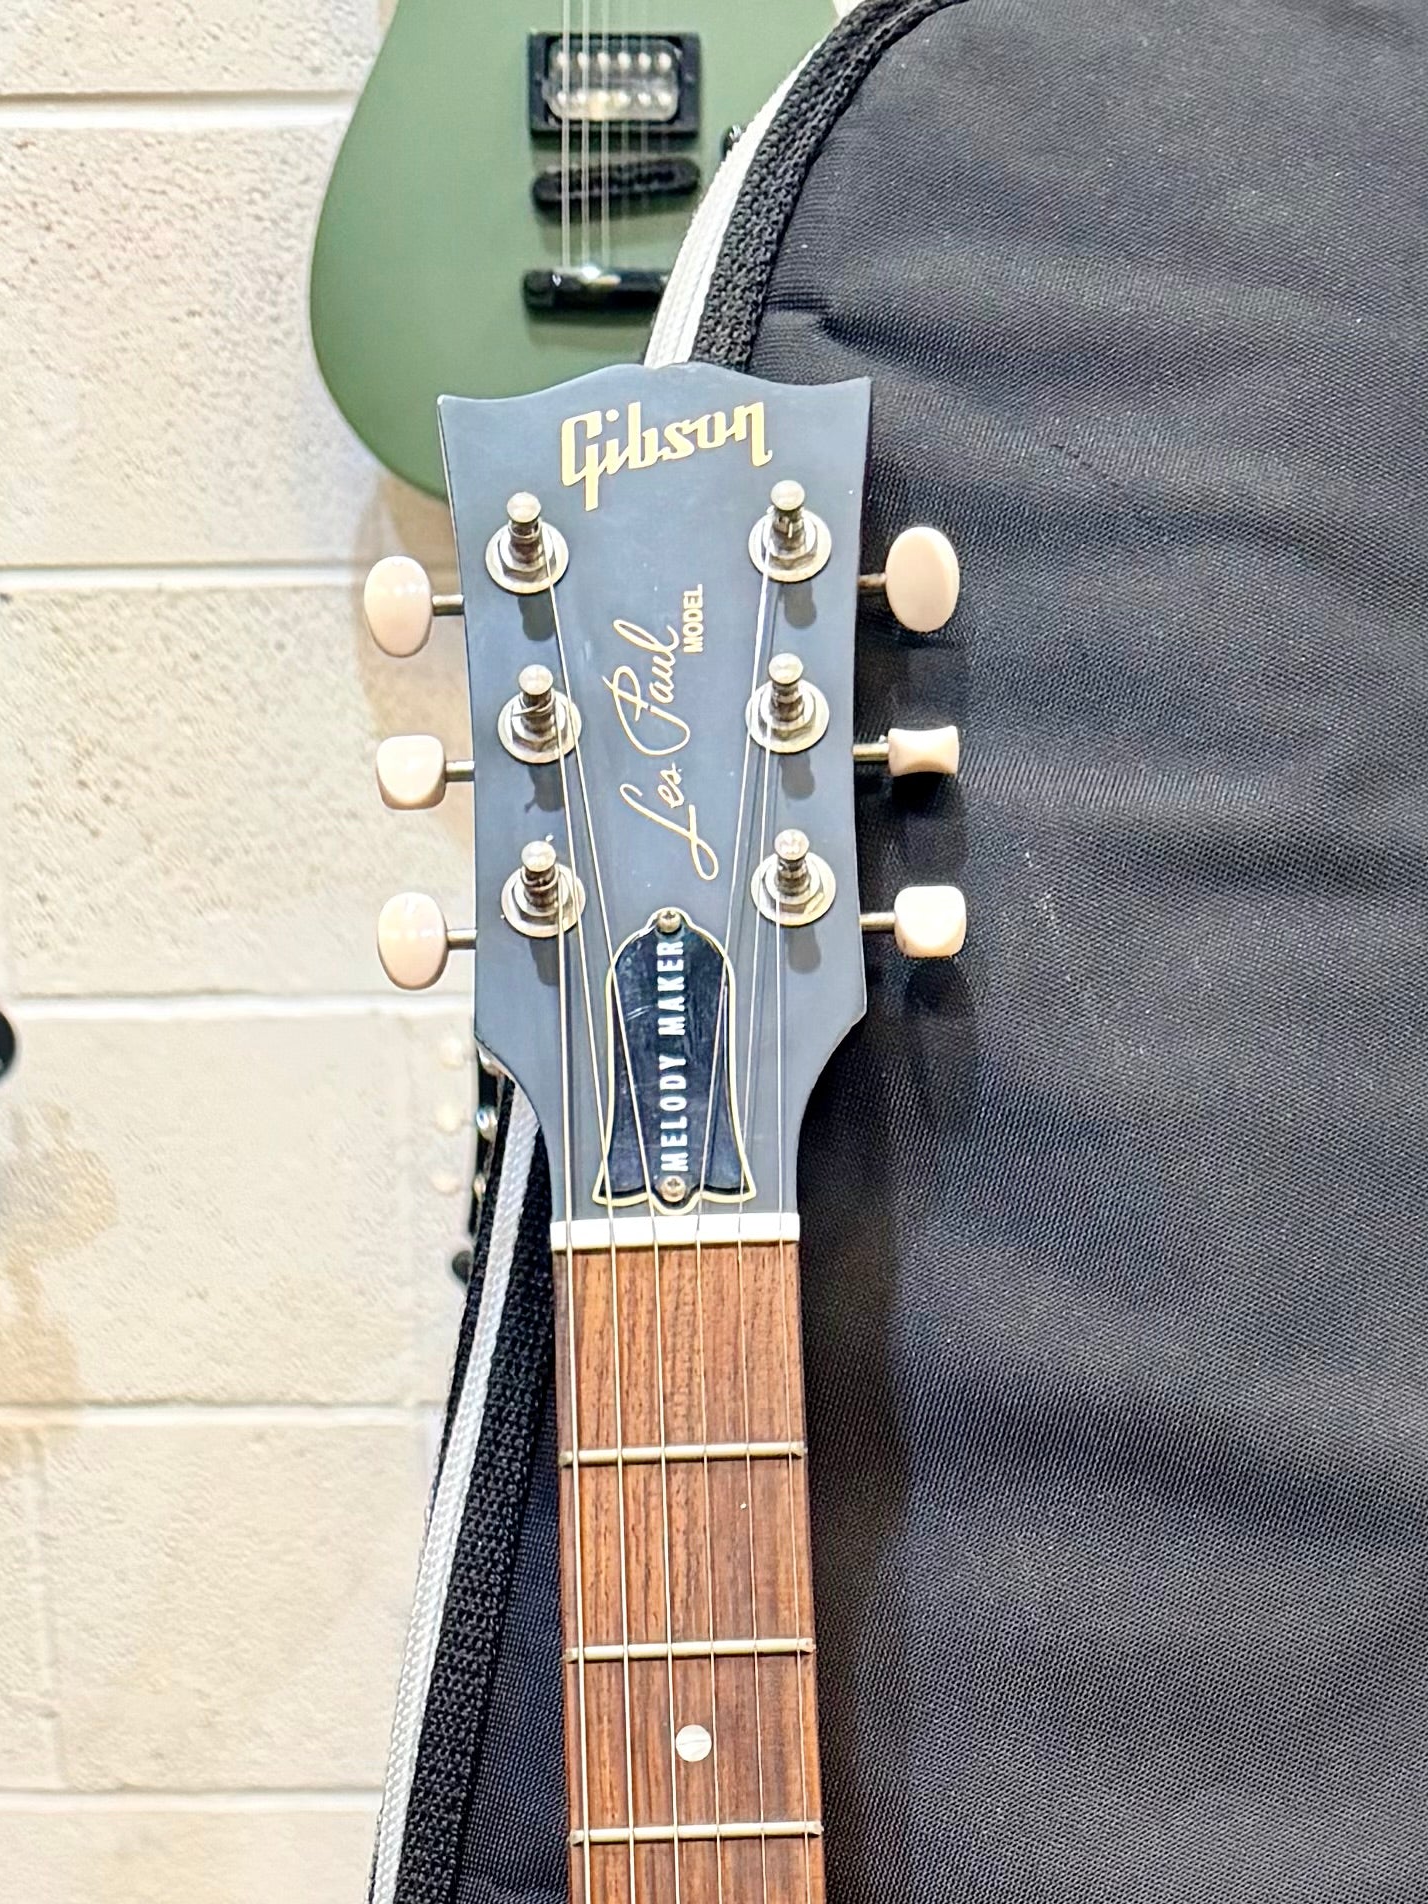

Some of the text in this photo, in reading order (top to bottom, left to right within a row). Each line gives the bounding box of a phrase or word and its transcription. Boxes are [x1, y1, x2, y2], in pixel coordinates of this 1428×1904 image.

[560, 401, 773, 512] Gibson
[602, 584, 719, 882] Les Paul MODEL
[657, 940, 689, 1173] MELODY MAKER
